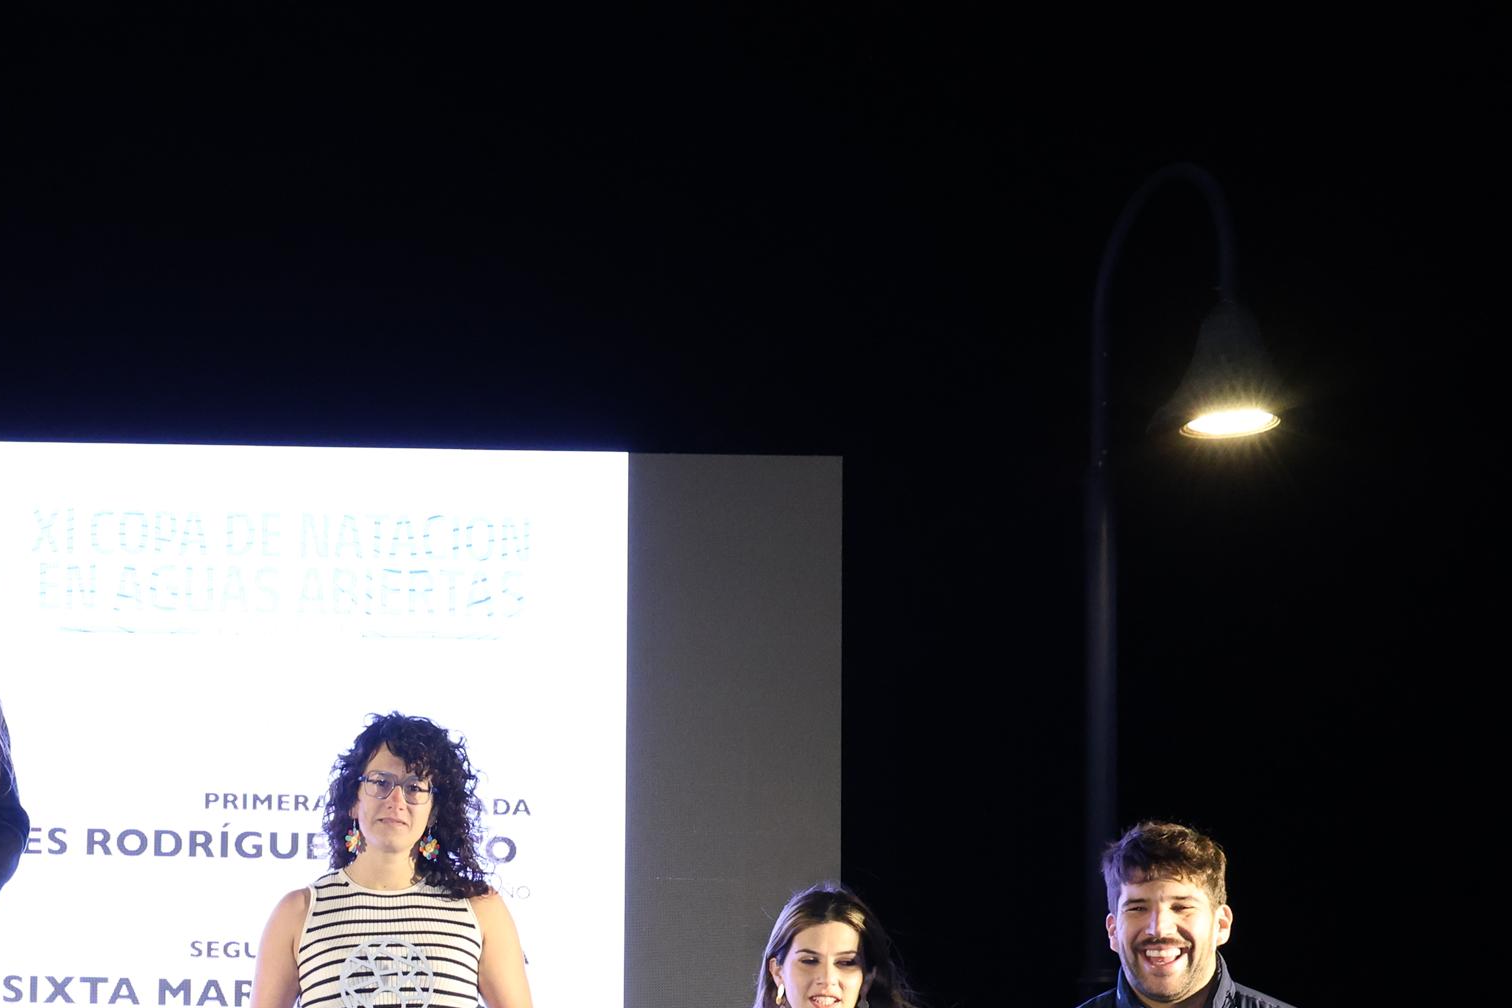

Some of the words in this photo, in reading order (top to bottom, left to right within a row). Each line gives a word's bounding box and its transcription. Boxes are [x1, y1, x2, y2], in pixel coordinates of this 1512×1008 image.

[30, 503, 76, 555] XI
[89, 509, 211, 556] COPA
[225, 511, 283, 558] DE
[300, 512, 533, 562] NATACION
[38, 562, 99, 611] EN
[112, 564, 281, 615] AGUAS
[297, 565, 528, 618] ABIERTAS
[86, 822, 329, 860] RODRÍGUE
[2, 975, 140, 1005] SIXTA
[158, 978, 253, 1008] MAR
